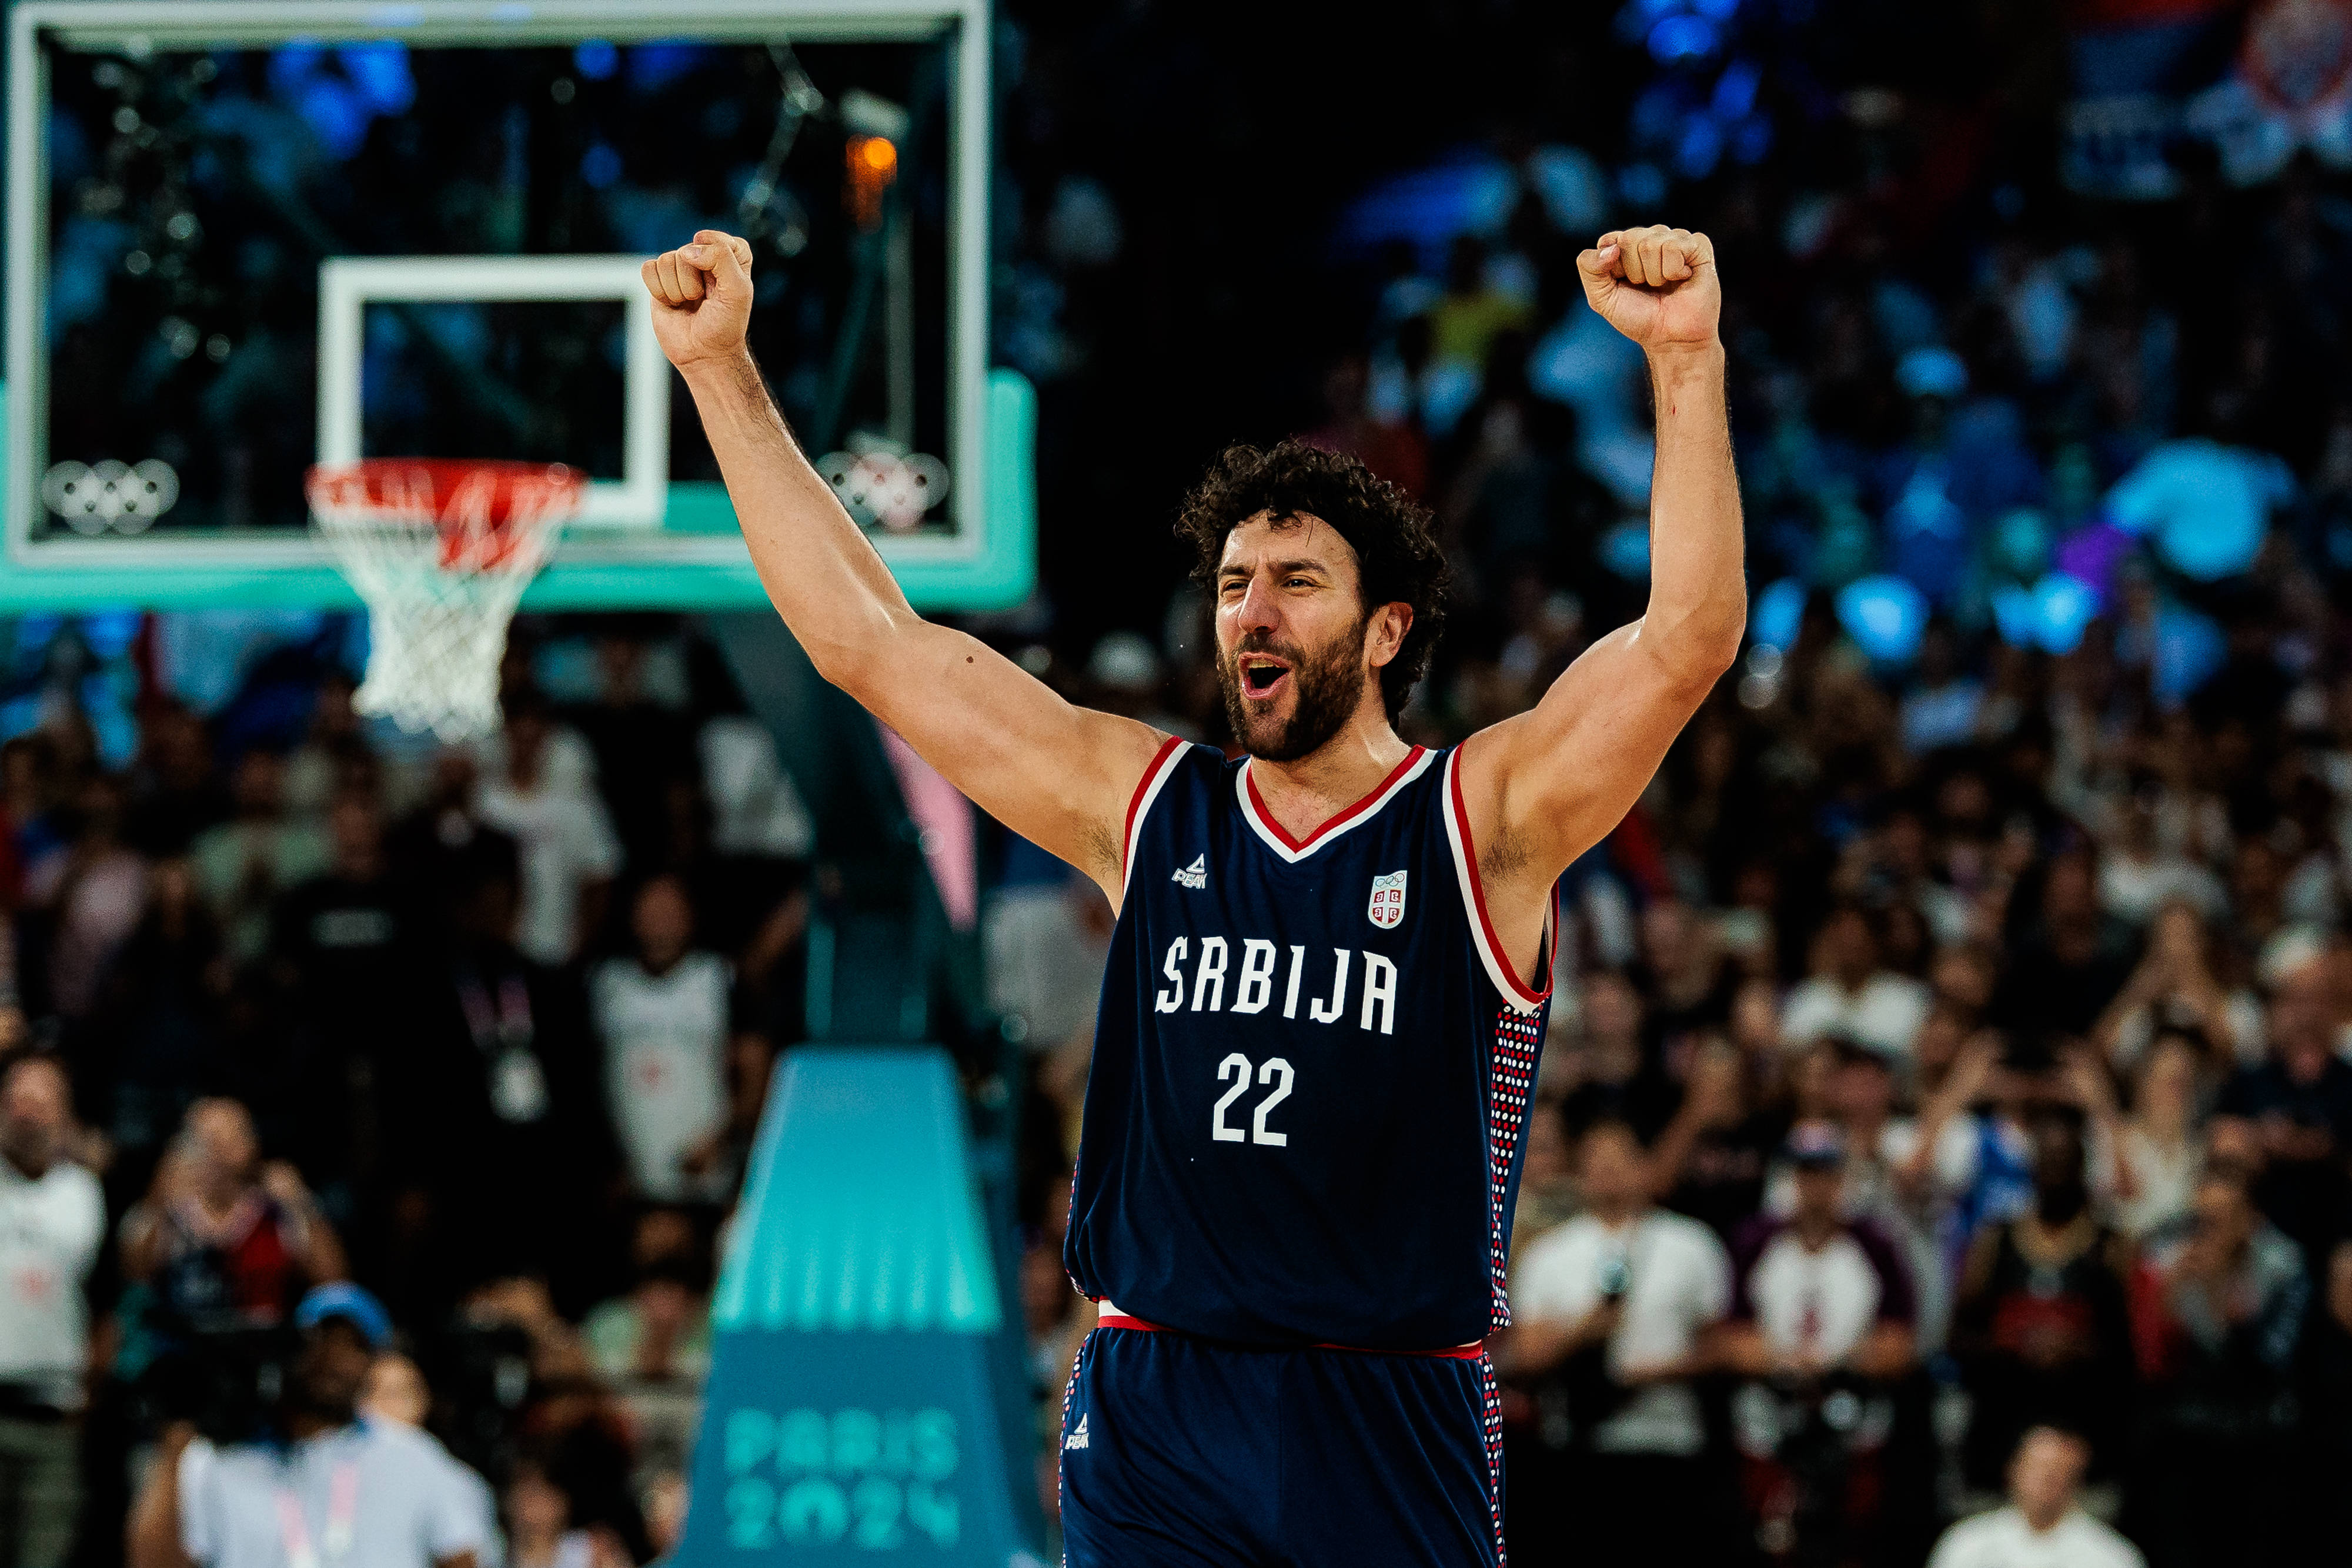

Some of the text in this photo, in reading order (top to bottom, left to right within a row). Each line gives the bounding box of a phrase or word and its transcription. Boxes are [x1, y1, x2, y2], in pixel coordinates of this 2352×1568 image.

[1155, 936, 1397, 1035] SRBIJA
[1213, 1053, 1294, 1146] 22
[725, 1409, 960, 1478] PARIS
[726, 1477, 961, 1550] 2024
